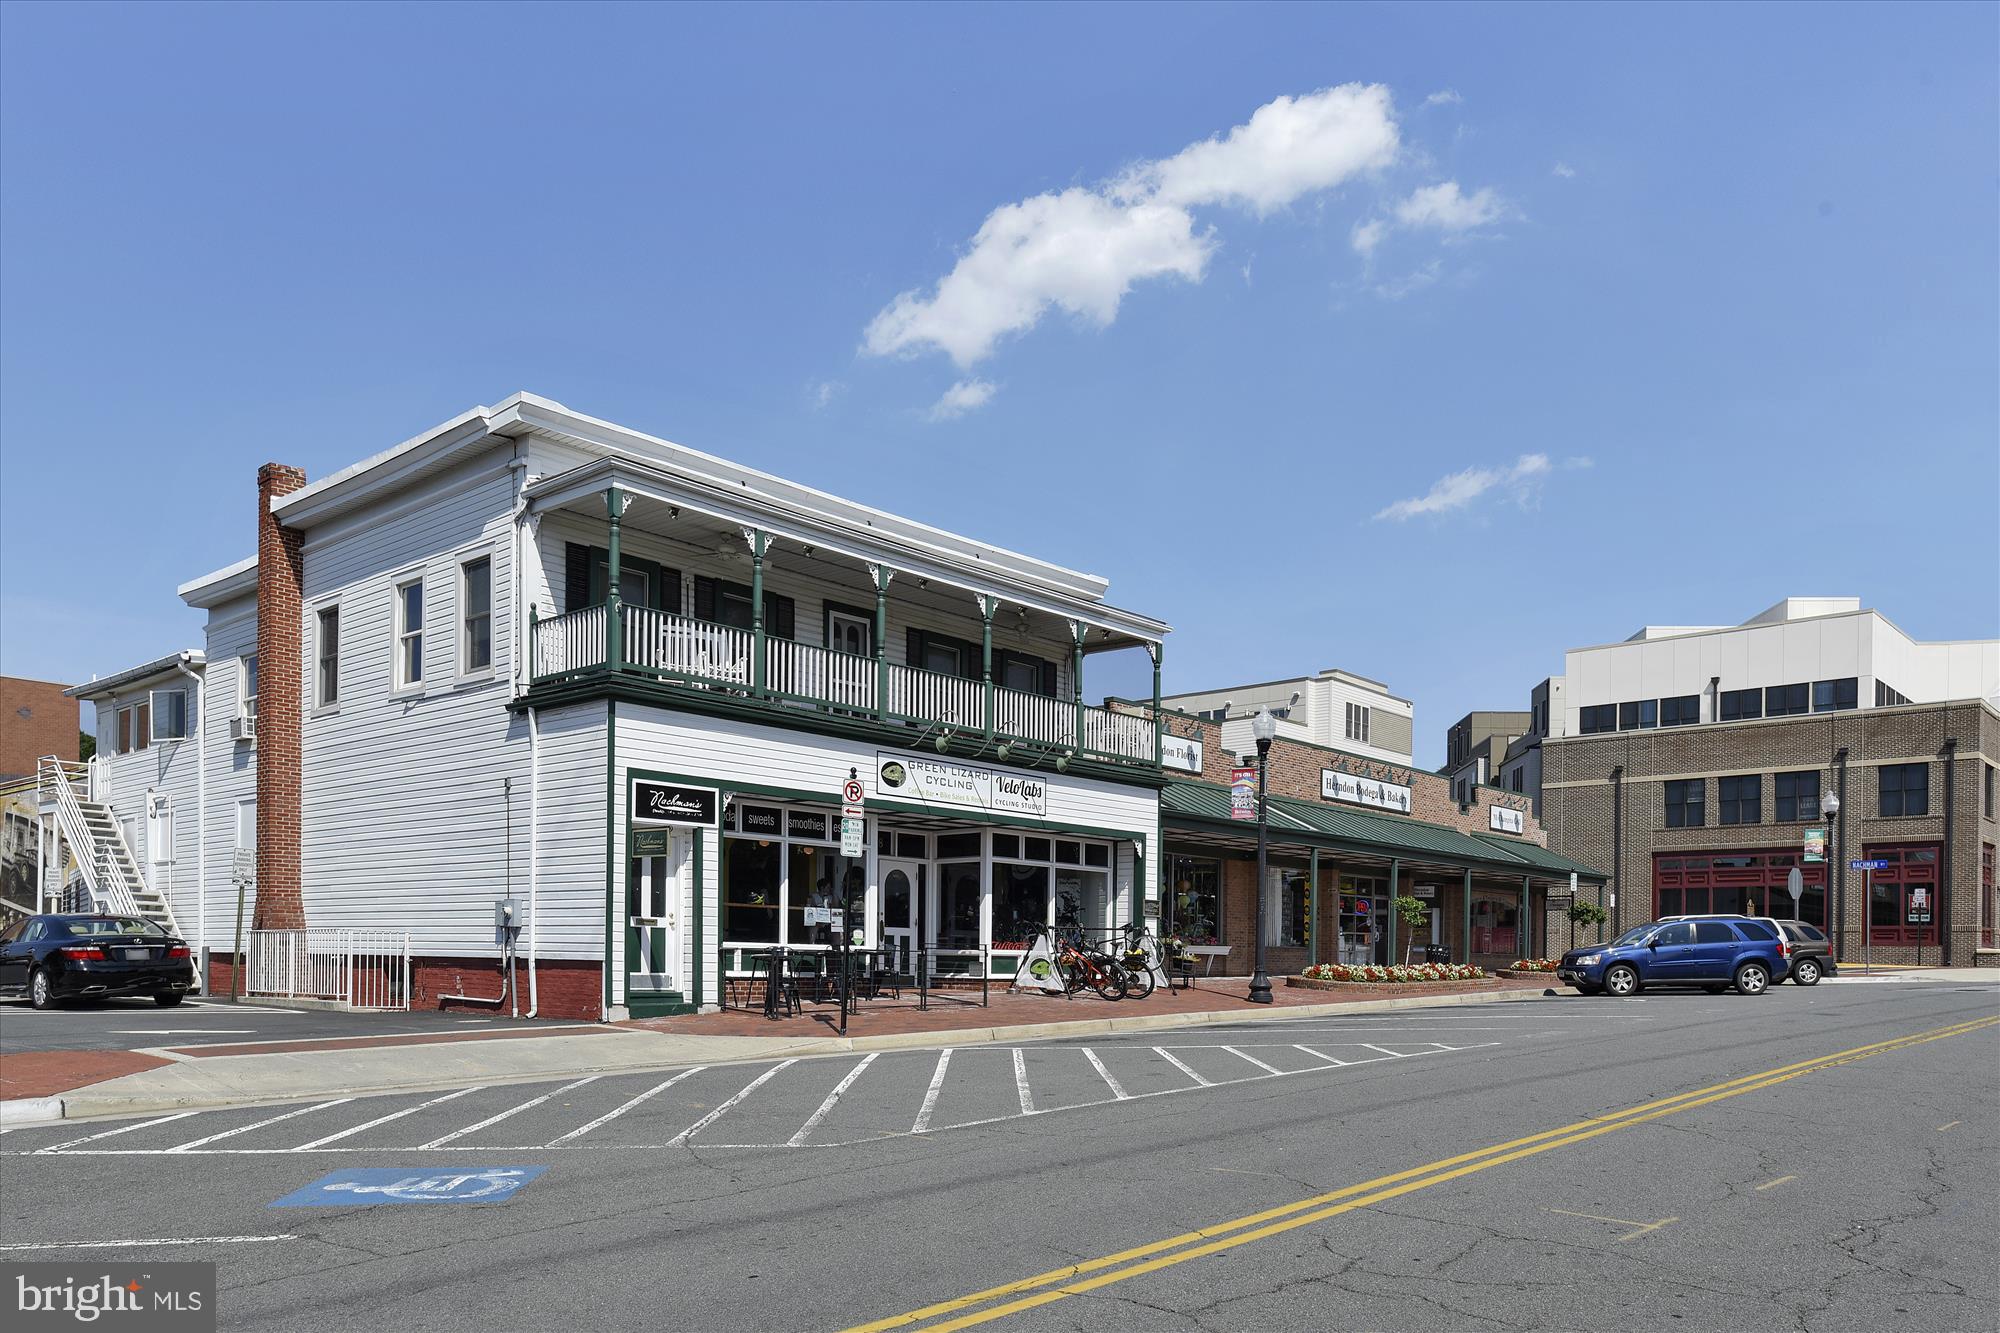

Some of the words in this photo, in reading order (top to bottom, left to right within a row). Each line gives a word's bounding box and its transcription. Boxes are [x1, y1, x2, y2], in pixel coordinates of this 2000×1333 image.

[1177, 748, 1199, 762] Florist
[908, 760, 947, 775] GREEN
[951, 766, 990, 781] LIZARD
[925, 776, 973, 791] CYCLING
[995, 776, 1042, 801] VeloLabs
[1326, 778, 1355, 794] Herndon
[1356, 783, 1379, 801] Bodega
[649, 790, 703, 812] Nachman's
[925, 789, 935, 797] Bar
[954, 793, 967, 801] Sales
[995, 798, 1020, 808] CYCLING
[1021, 801, 1043, 812] STUDIO
[723, 811, 736, 823] oda
[748, 813, 775, 826] sweets
[788, 817, 825, 833] smoothies
